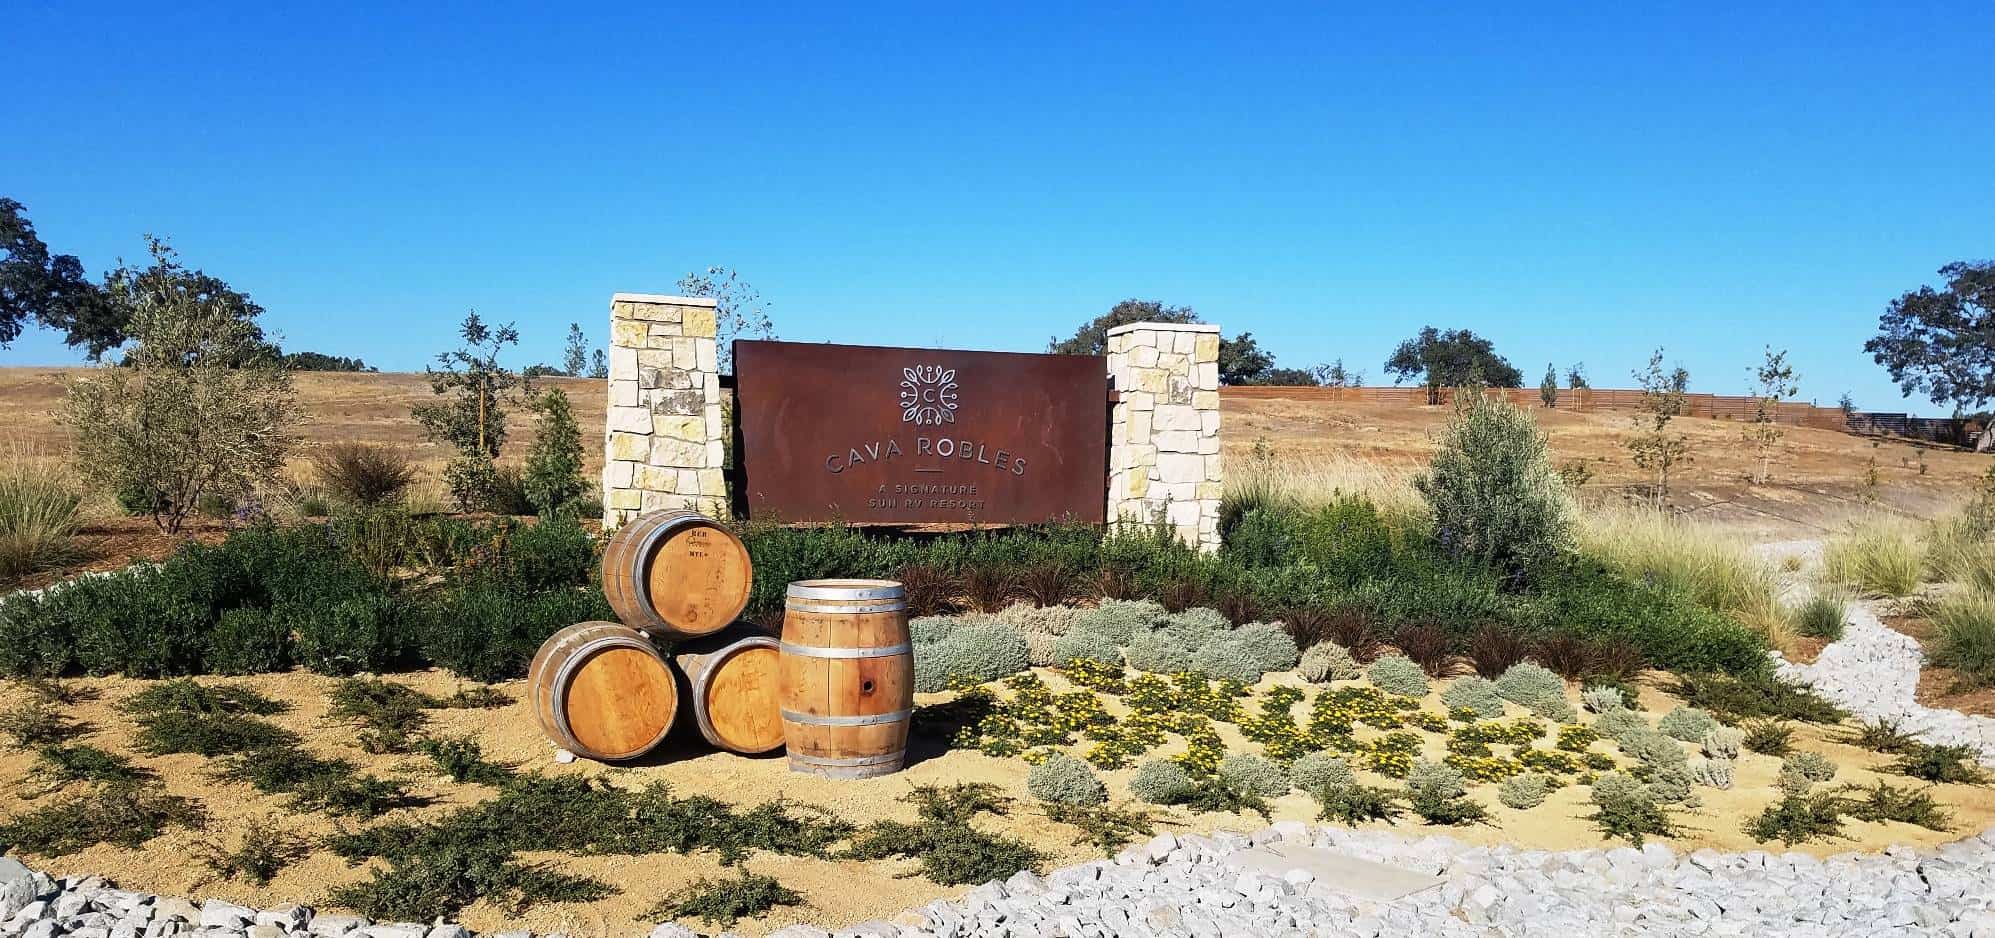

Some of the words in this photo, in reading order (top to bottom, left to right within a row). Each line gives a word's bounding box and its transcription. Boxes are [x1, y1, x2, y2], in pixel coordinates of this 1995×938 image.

[923, 388, 936, 403] C
[825, 439, 903, 473] CAVA
[917, 437, 1027, 475] ROBLES
[879, 484, 886, 495] A
[895, 484, 978, 496] SIGNATURE
[868, 499, 898, 510] SUN
[904, 499, 924, 510] RV
[929, 499, 985, 510] RESORT
